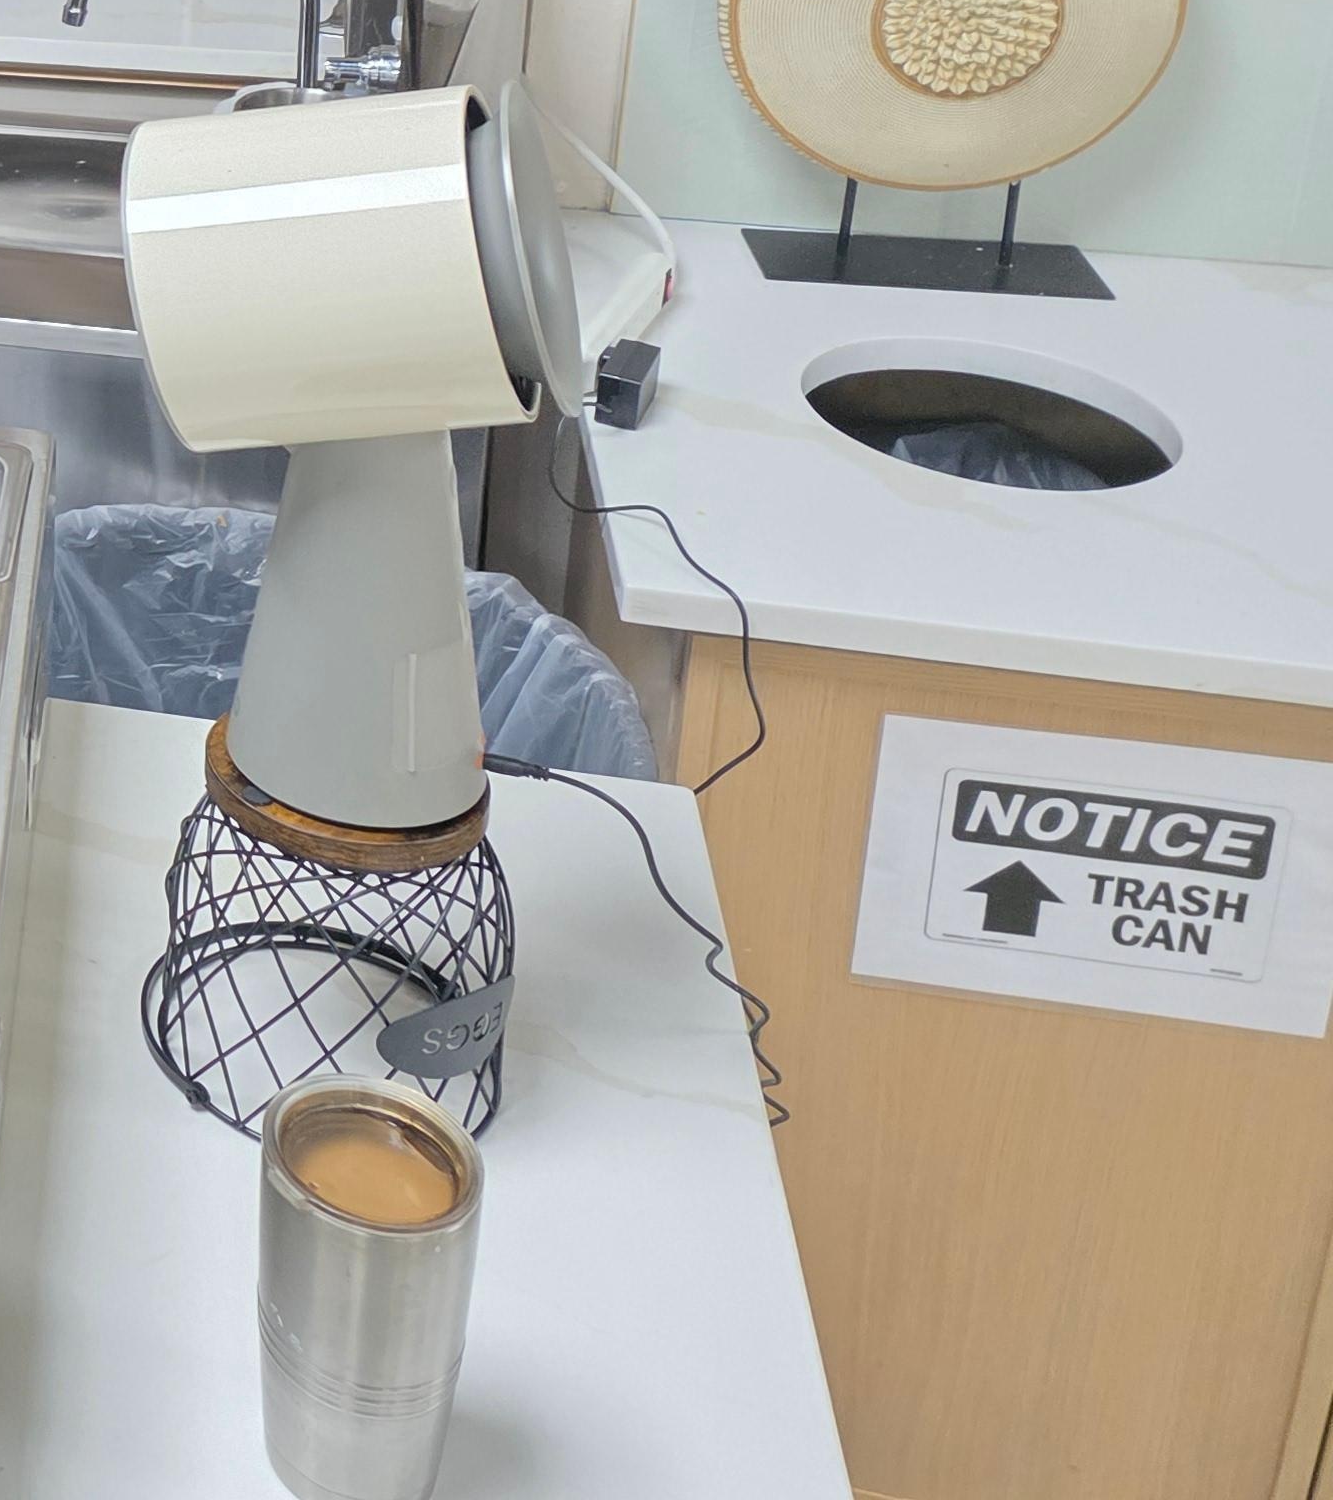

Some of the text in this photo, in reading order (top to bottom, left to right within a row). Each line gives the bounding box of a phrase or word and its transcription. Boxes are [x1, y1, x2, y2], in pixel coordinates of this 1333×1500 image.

[964, 789, 1267, 867] NOTICE
[1087, 873, 1249, 924] TRASH
[1111, 914, 1213, 955] CAN
[421, 1001, 503, 1054] EGGS
